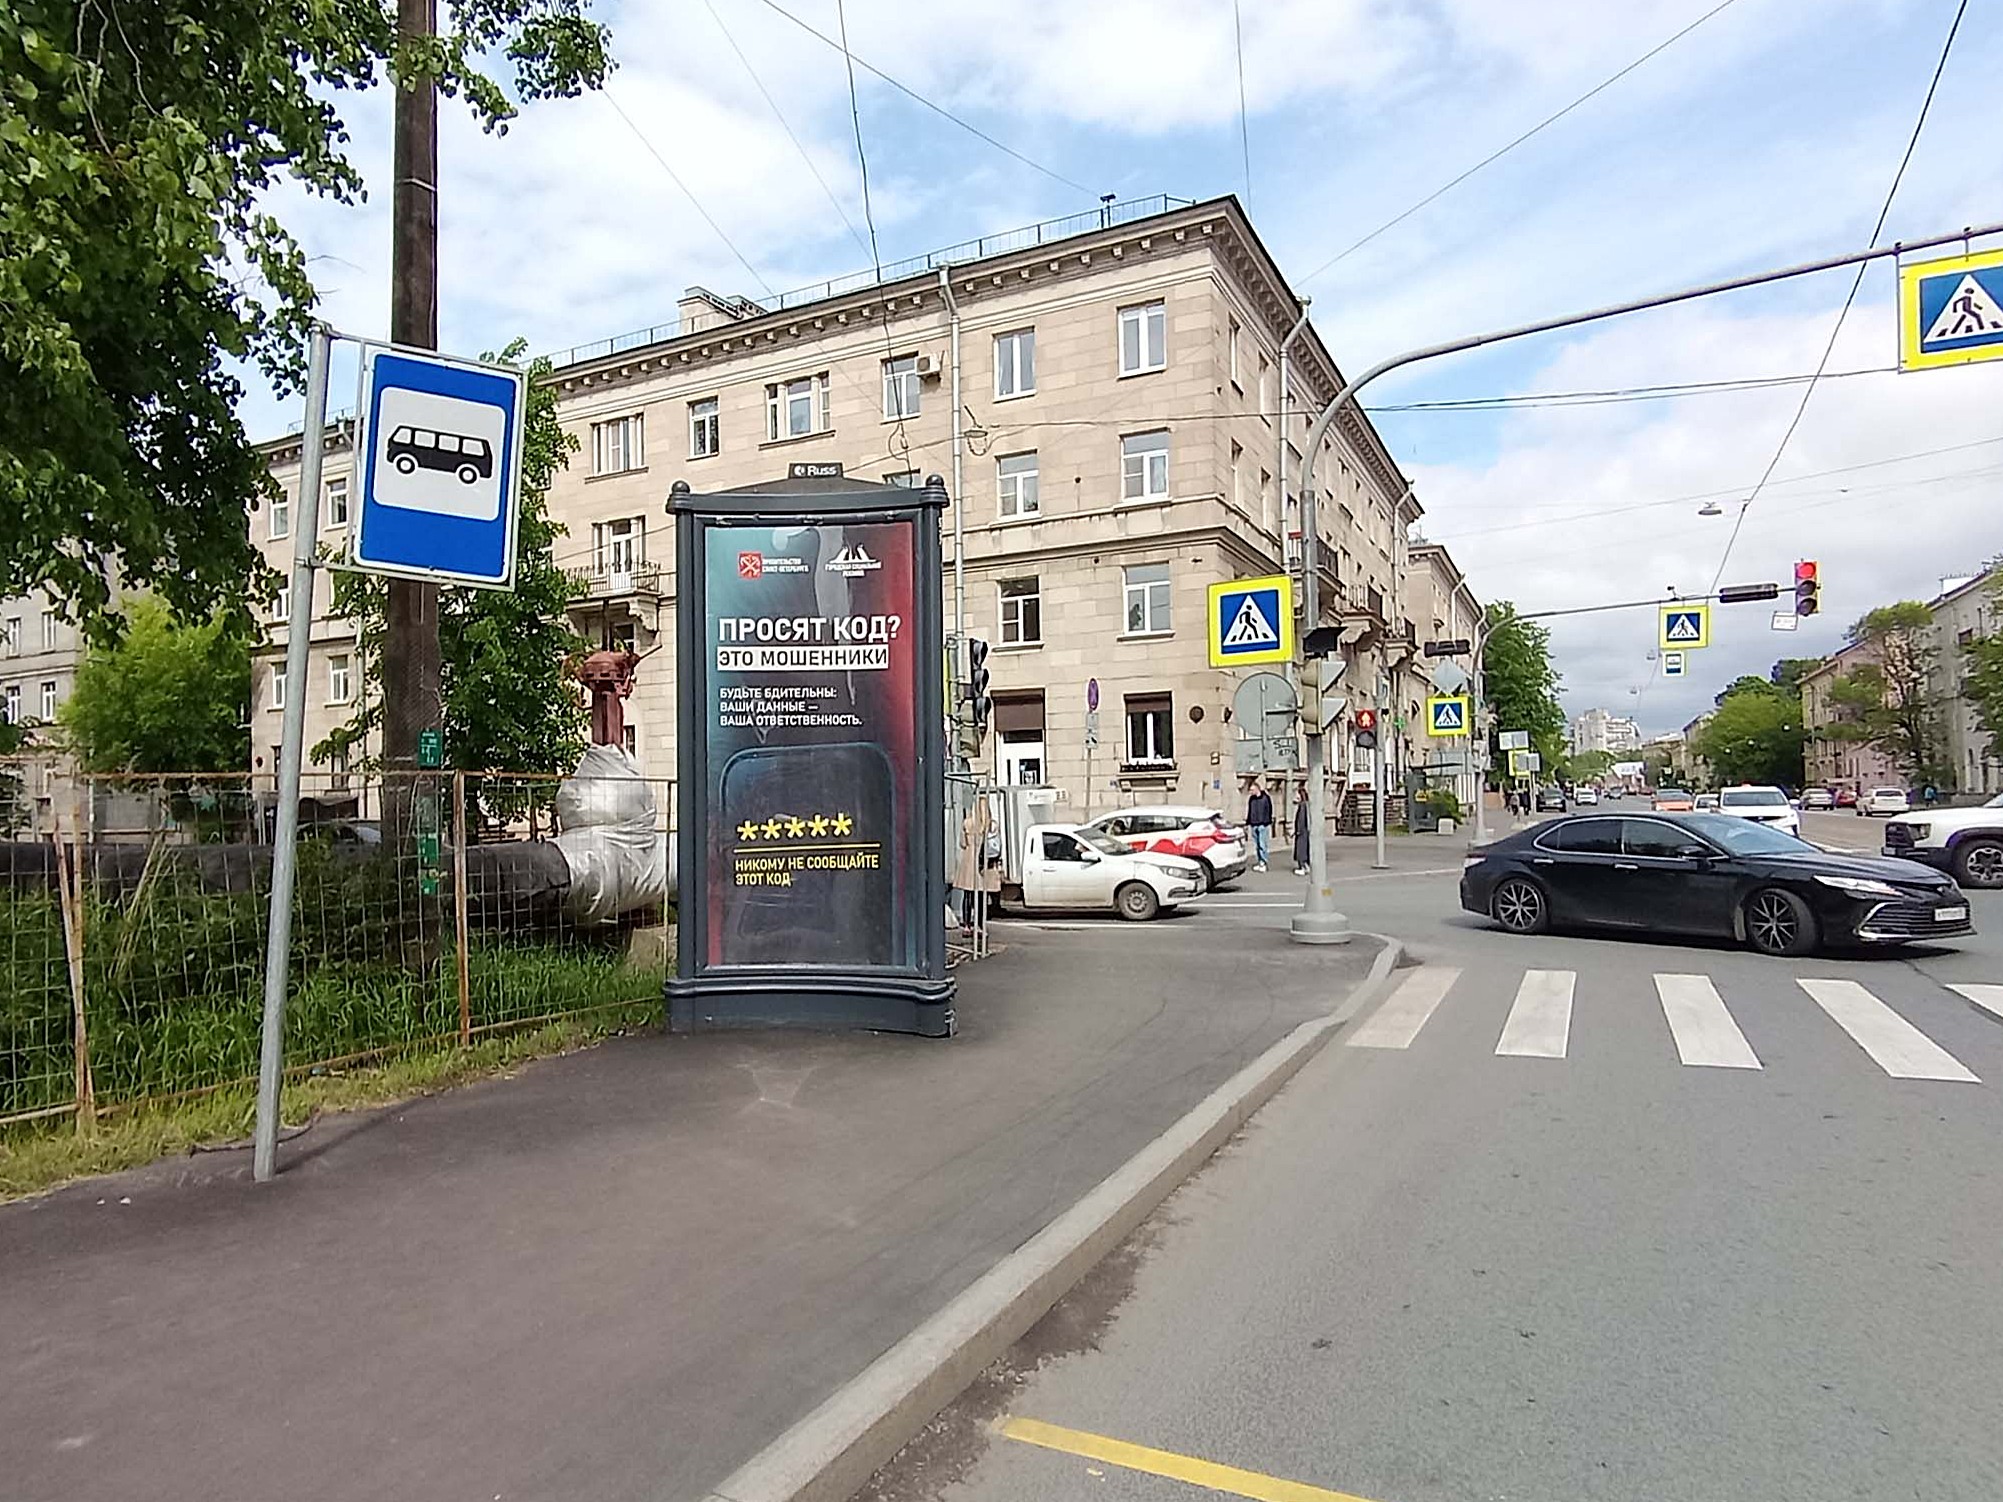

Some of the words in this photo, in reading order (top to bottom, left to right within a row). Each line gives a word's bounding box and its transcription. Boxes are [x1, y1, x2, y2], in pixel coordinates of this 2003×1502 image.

[807, 465, 837, 476] Russ
[719, 617, 826, 641] ПРОСЯТ
[834, 615, 901, 643] КОД?
[719, 651, 753, 666] ЭТО
[761, 649, 887, 666] МОШЕННИКИ
[720, 687, 762, 700] БУДЬТЕ
[764, 686, 837, 700] БДИТЕЛЬНЫ:
[720, 701, 753, 713] ВАШИ
[756, 700, 806, 713] ДАННЫЕ
[720, 715, 753, 726] ВАША
[756, 714, 862, 726] ОТВЕТСТВЕННОСТЬ.
[735, 858, 786, 871] НИКОМУ
[788, 857, 804, 869] НЕ
[807, 852, 879, 870] СООБЩАЙТЕ
[736, 873, 764, 885] ЭТОТ
[766, 872, 791, 886] КОД
